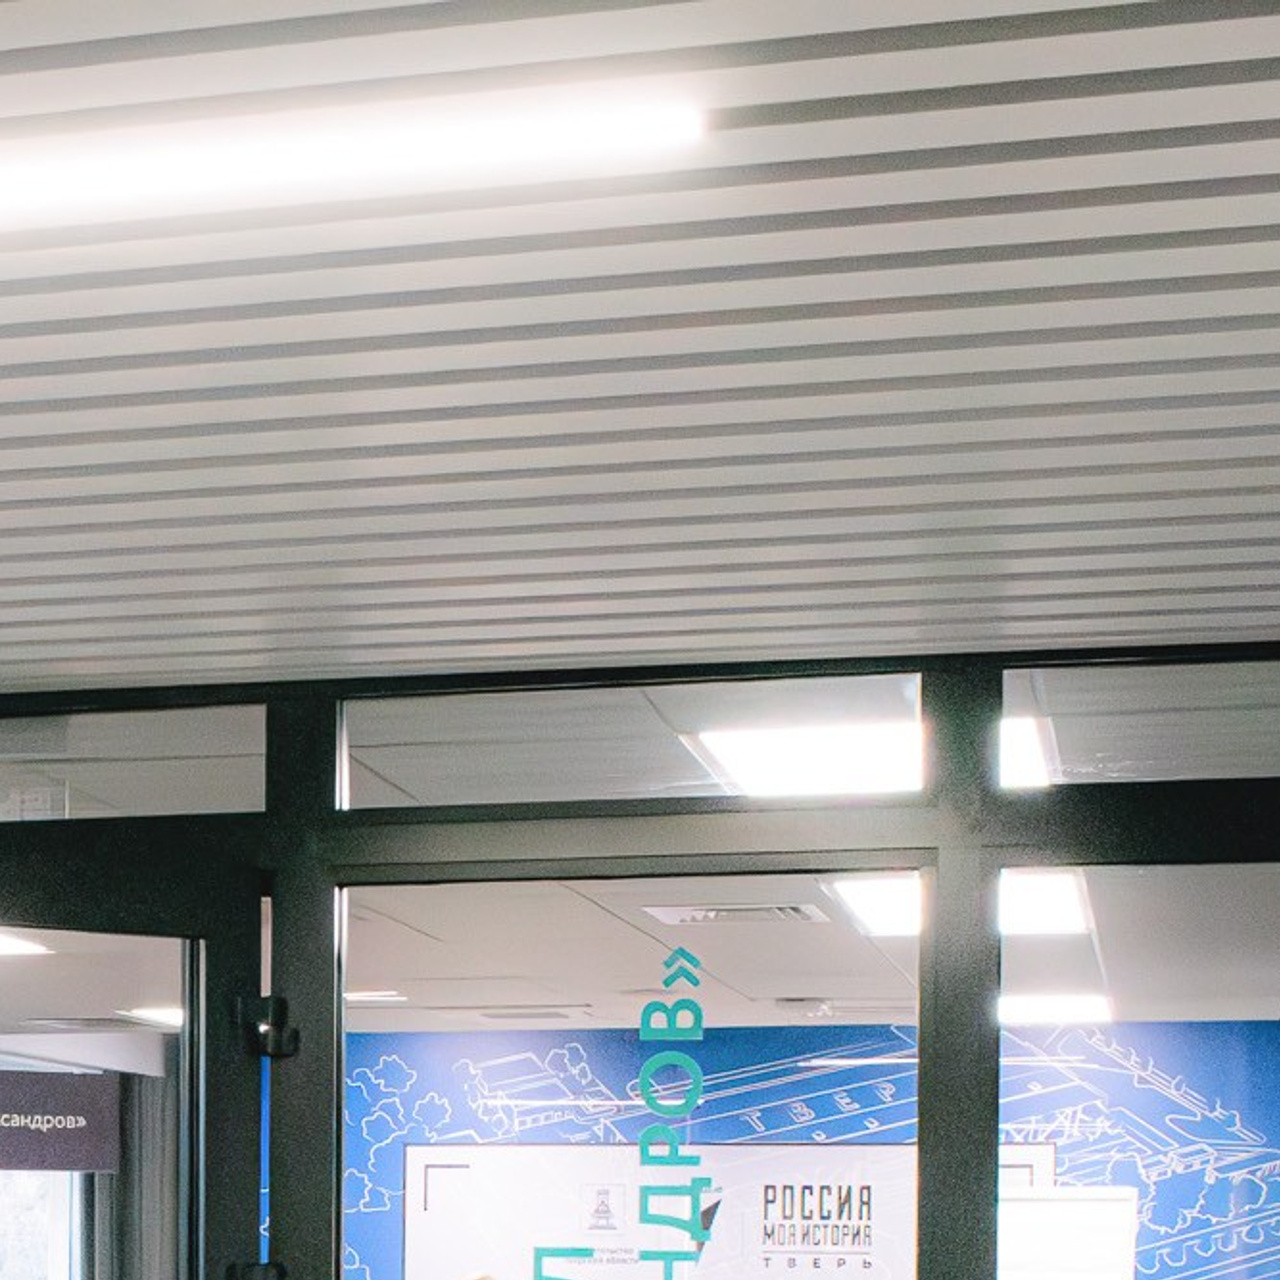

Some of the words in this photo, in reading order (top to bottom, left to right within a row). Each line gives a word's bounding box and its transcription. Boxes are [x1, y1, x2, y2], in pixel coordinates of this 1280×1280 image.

[763, 1184, 872, 1221] РОССИЯ
[762, 1223, 797, 1247] МОЯ
[800, 1223, 873, 1247] ИСТОРИЯ
[763, 1257, 873, 1269] ТВЕРЬ
